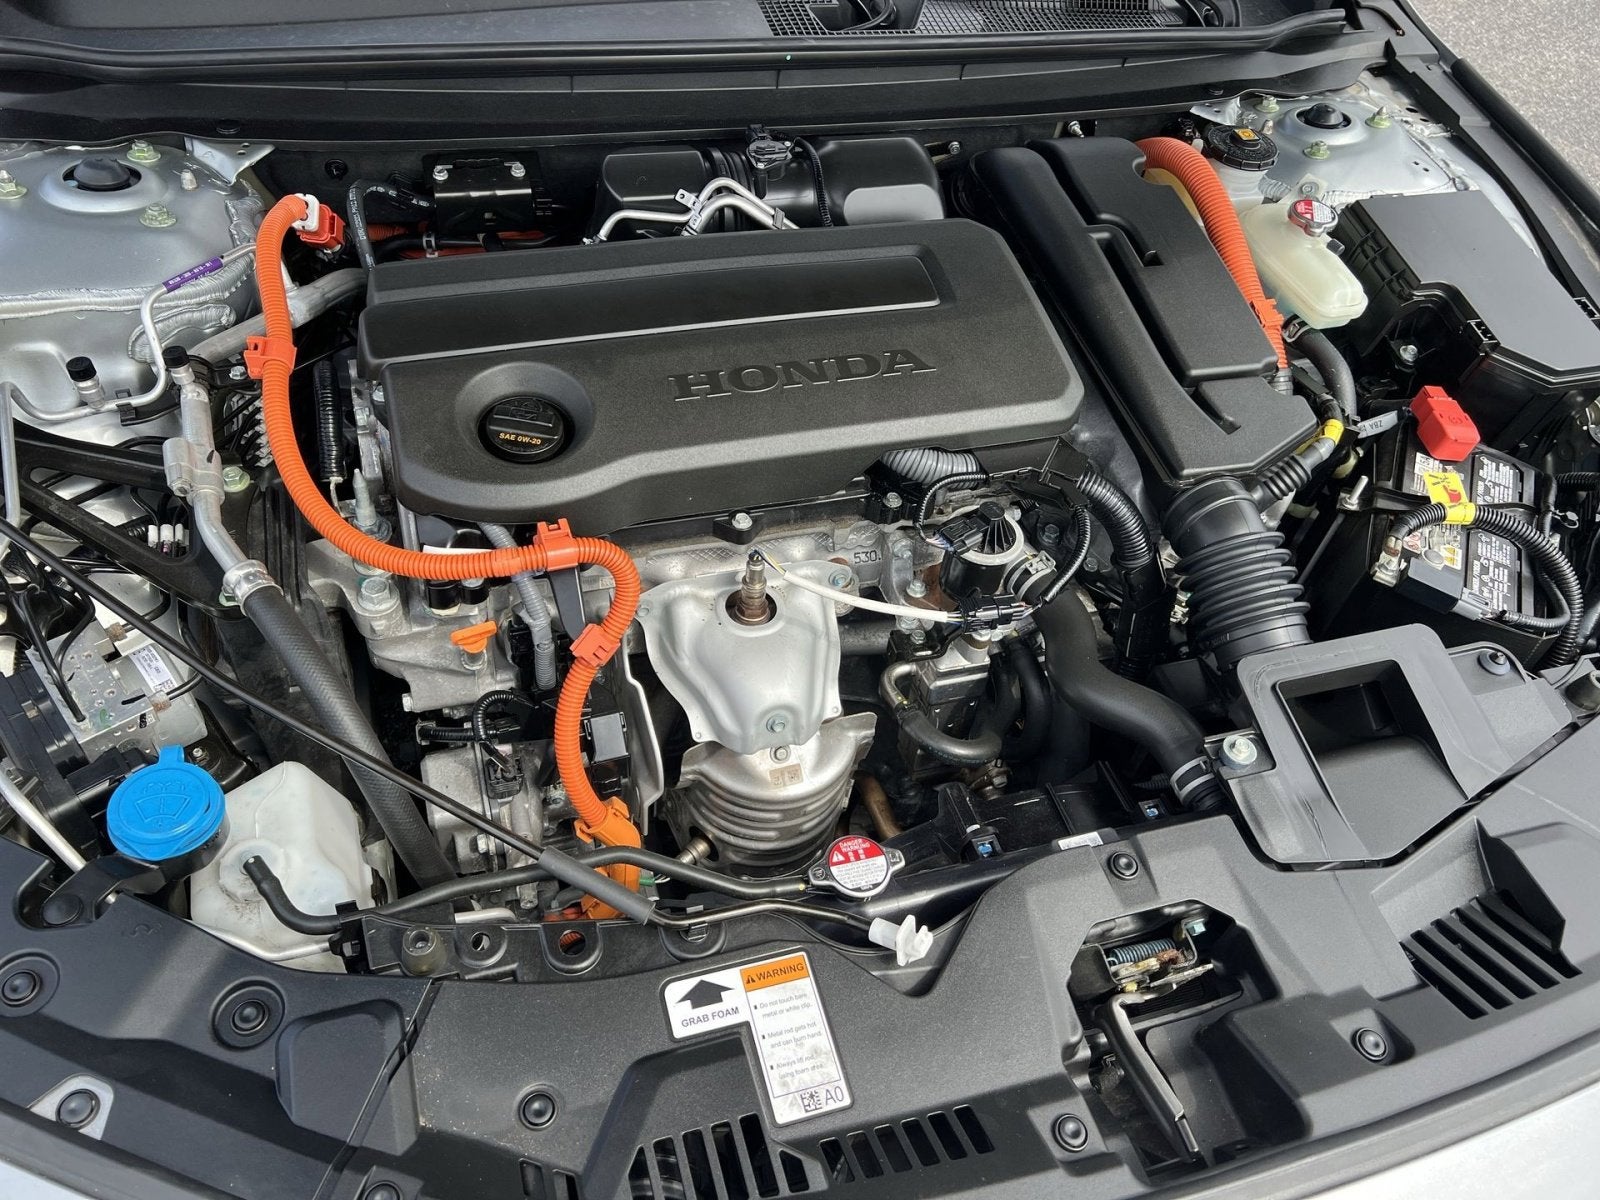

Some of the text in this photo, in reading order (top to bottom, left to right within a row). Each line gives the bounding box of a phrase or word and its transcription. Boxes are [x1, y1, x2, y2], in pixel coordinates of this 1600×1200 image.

[667, 349, 937, 401] HONDA
[499, 432, 541, 445] SAE 0W-20
[755, 963, 804, 981] WARNING
[778, 996, 794, 1004] touch
[681, 1006, 740, 1028] GRAB FOAM
[825, 1085, 845, 1105] A0
